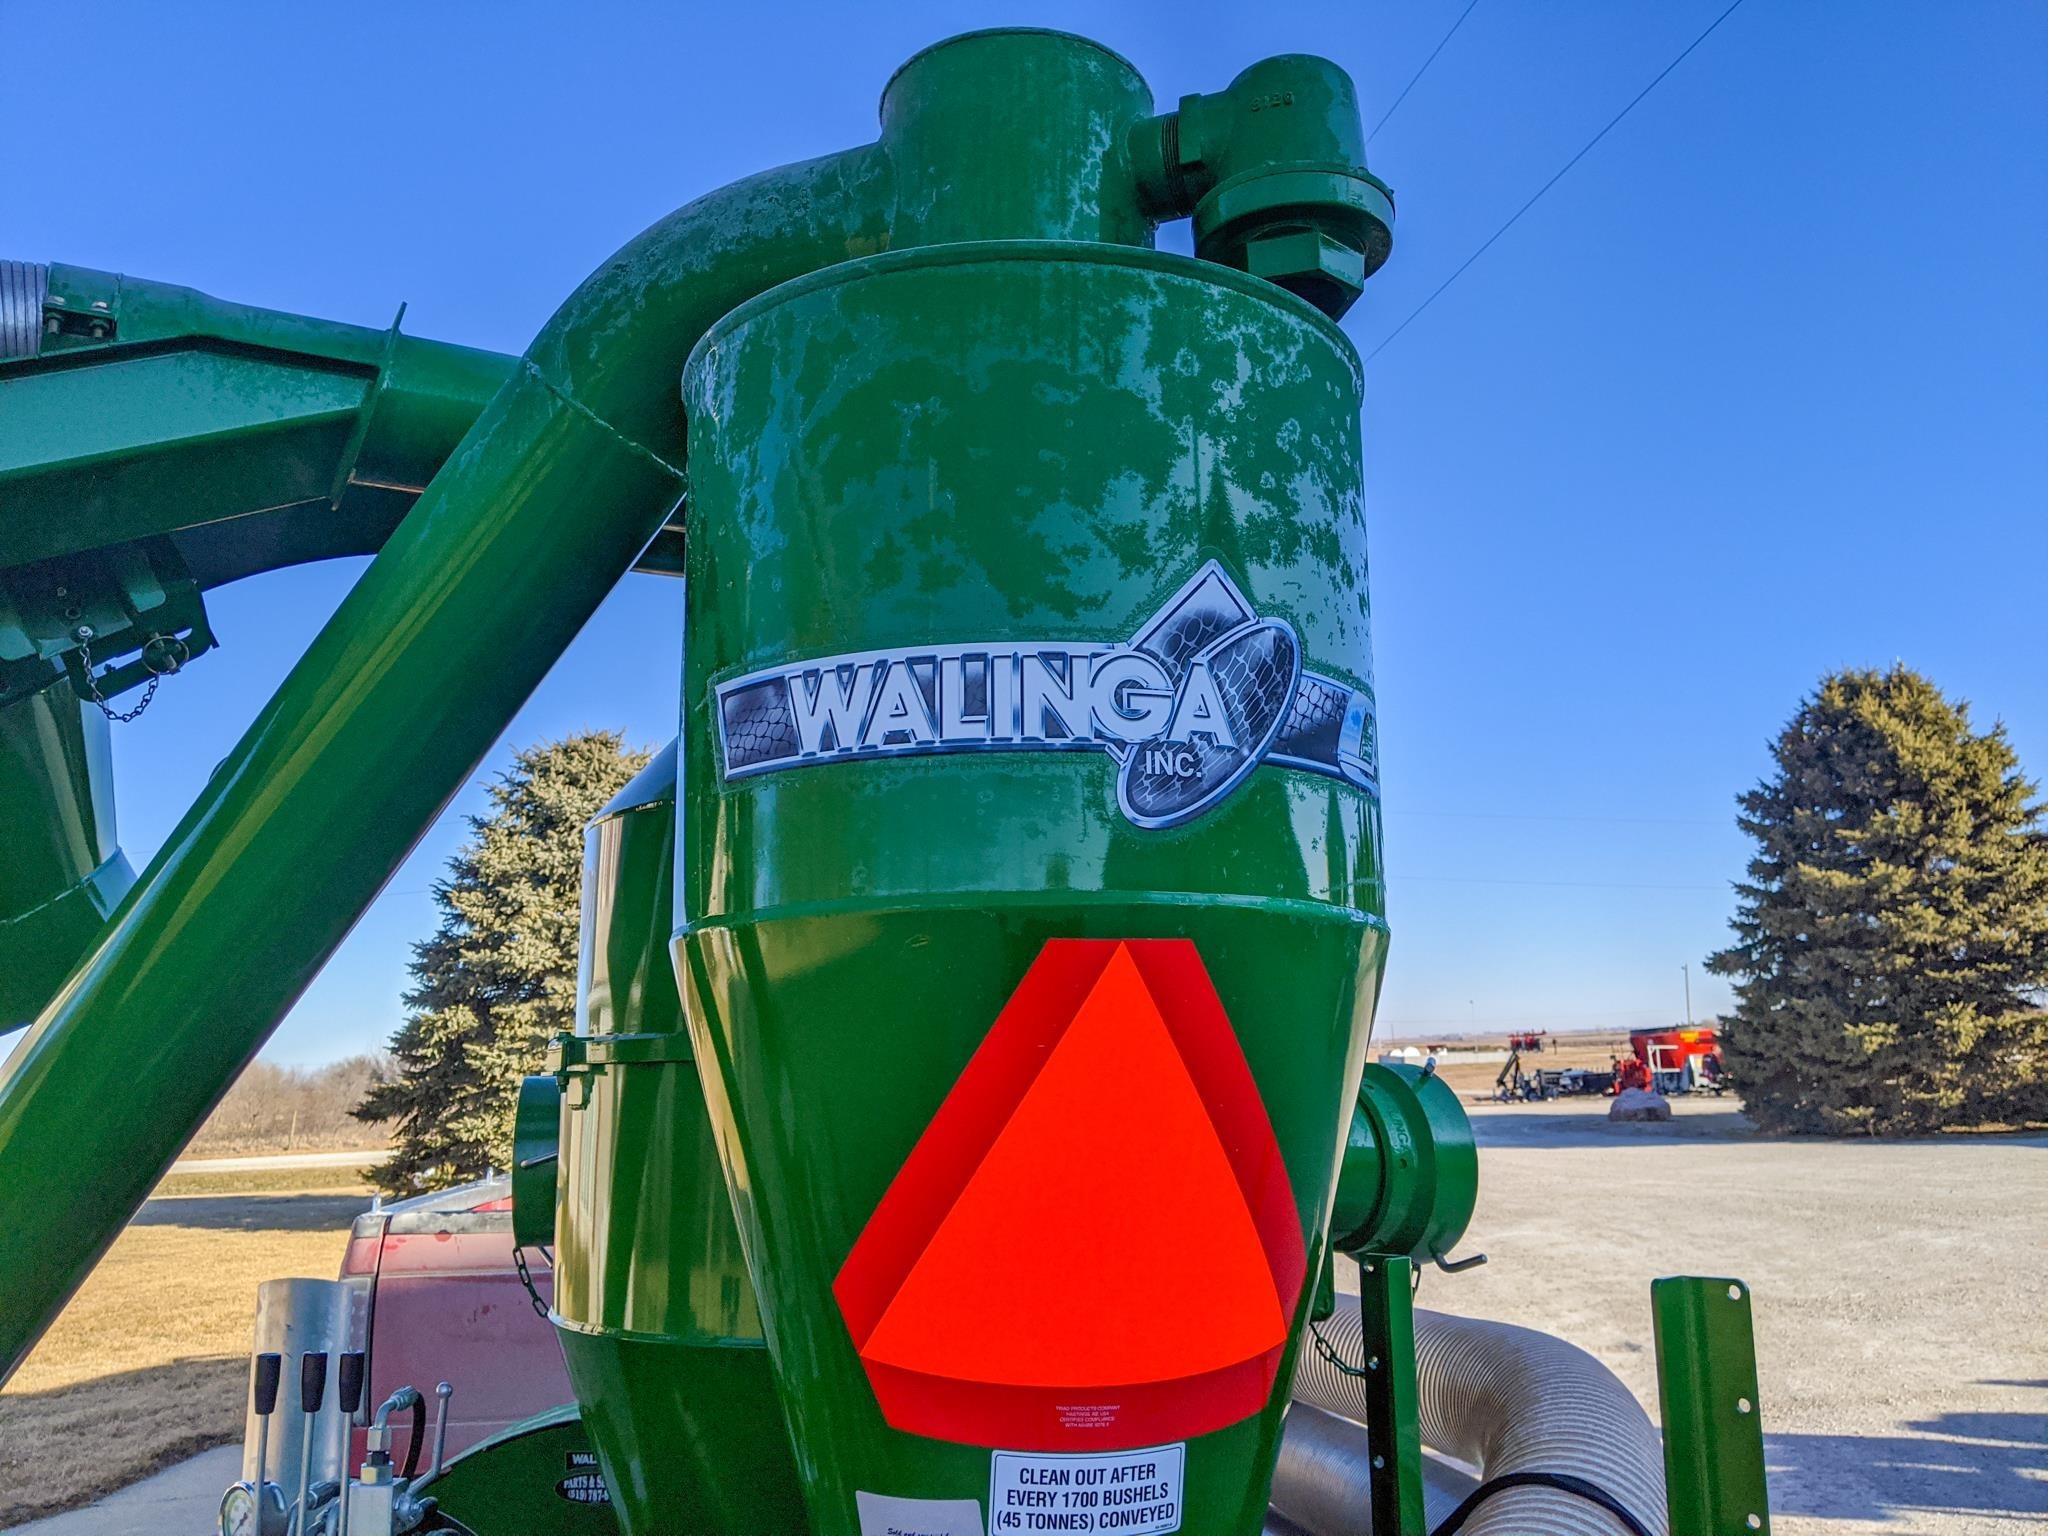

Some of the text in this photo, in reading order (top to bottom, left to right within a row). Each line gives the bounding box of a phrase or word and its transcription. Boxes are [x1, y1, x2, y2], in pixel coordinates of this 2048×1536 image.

[787, 651, 1238, 757] WALINGA
[1145, 750, 1202, 778] INC.
[564, 1475, 587, 1488] PARTS
[1019, 1463, 1156, 1486] CLEAN OUT AFTER
[1007, 1482, 1169, 1508] EVERY 1700 BUSHELS
[997, 1510, 1021, 1531] (45
[1026, 1512, 1095, 1534] TONNES)
[1099, 1502, 1175, 1529] CONVEYED
